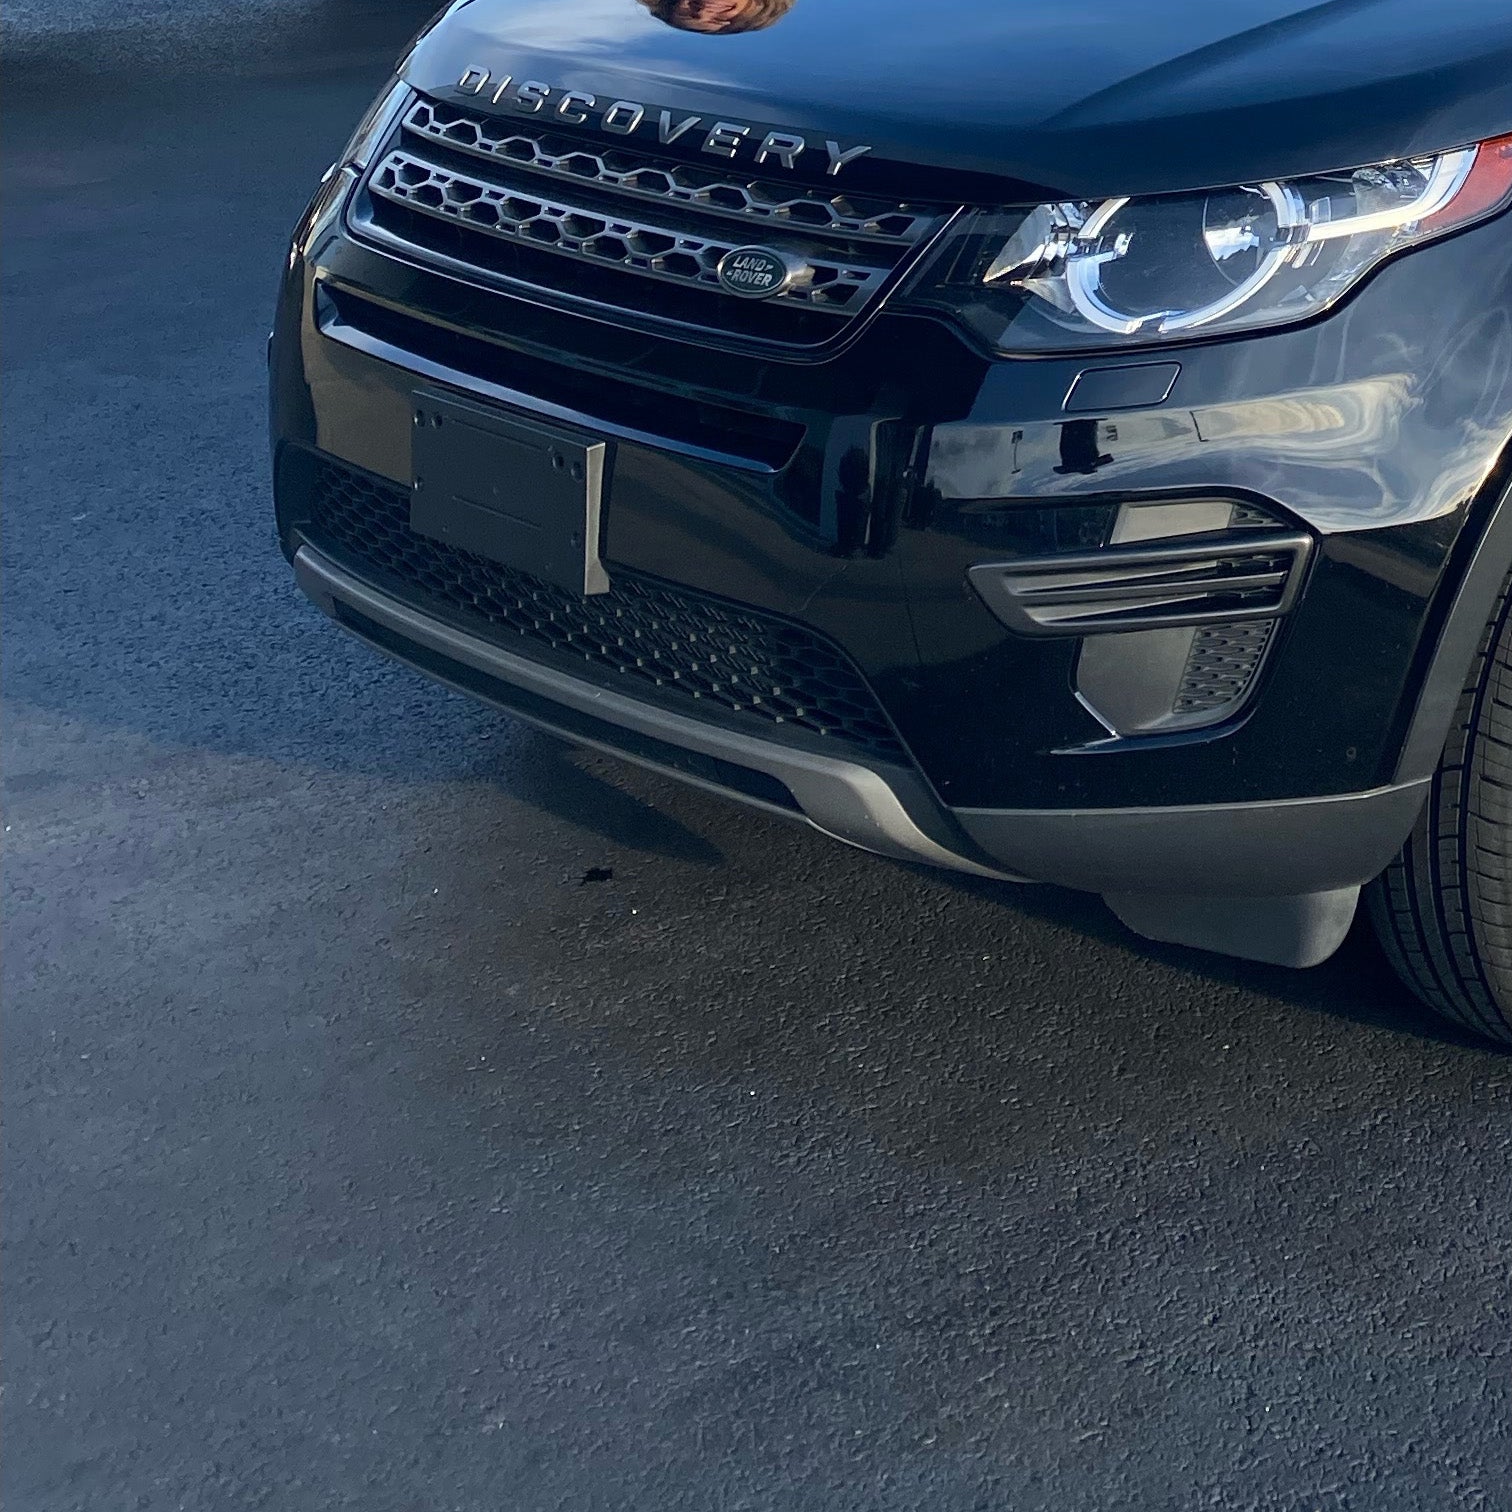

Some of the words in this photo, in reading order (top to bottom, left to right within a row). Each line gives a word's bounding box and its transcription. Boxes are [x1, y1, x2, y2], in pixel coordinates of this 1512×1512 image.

[456, 63, 871, 176] DISCOVERY
[732, 255, 768, 271] LAND
[730, 268, 773, 287] ROVER
